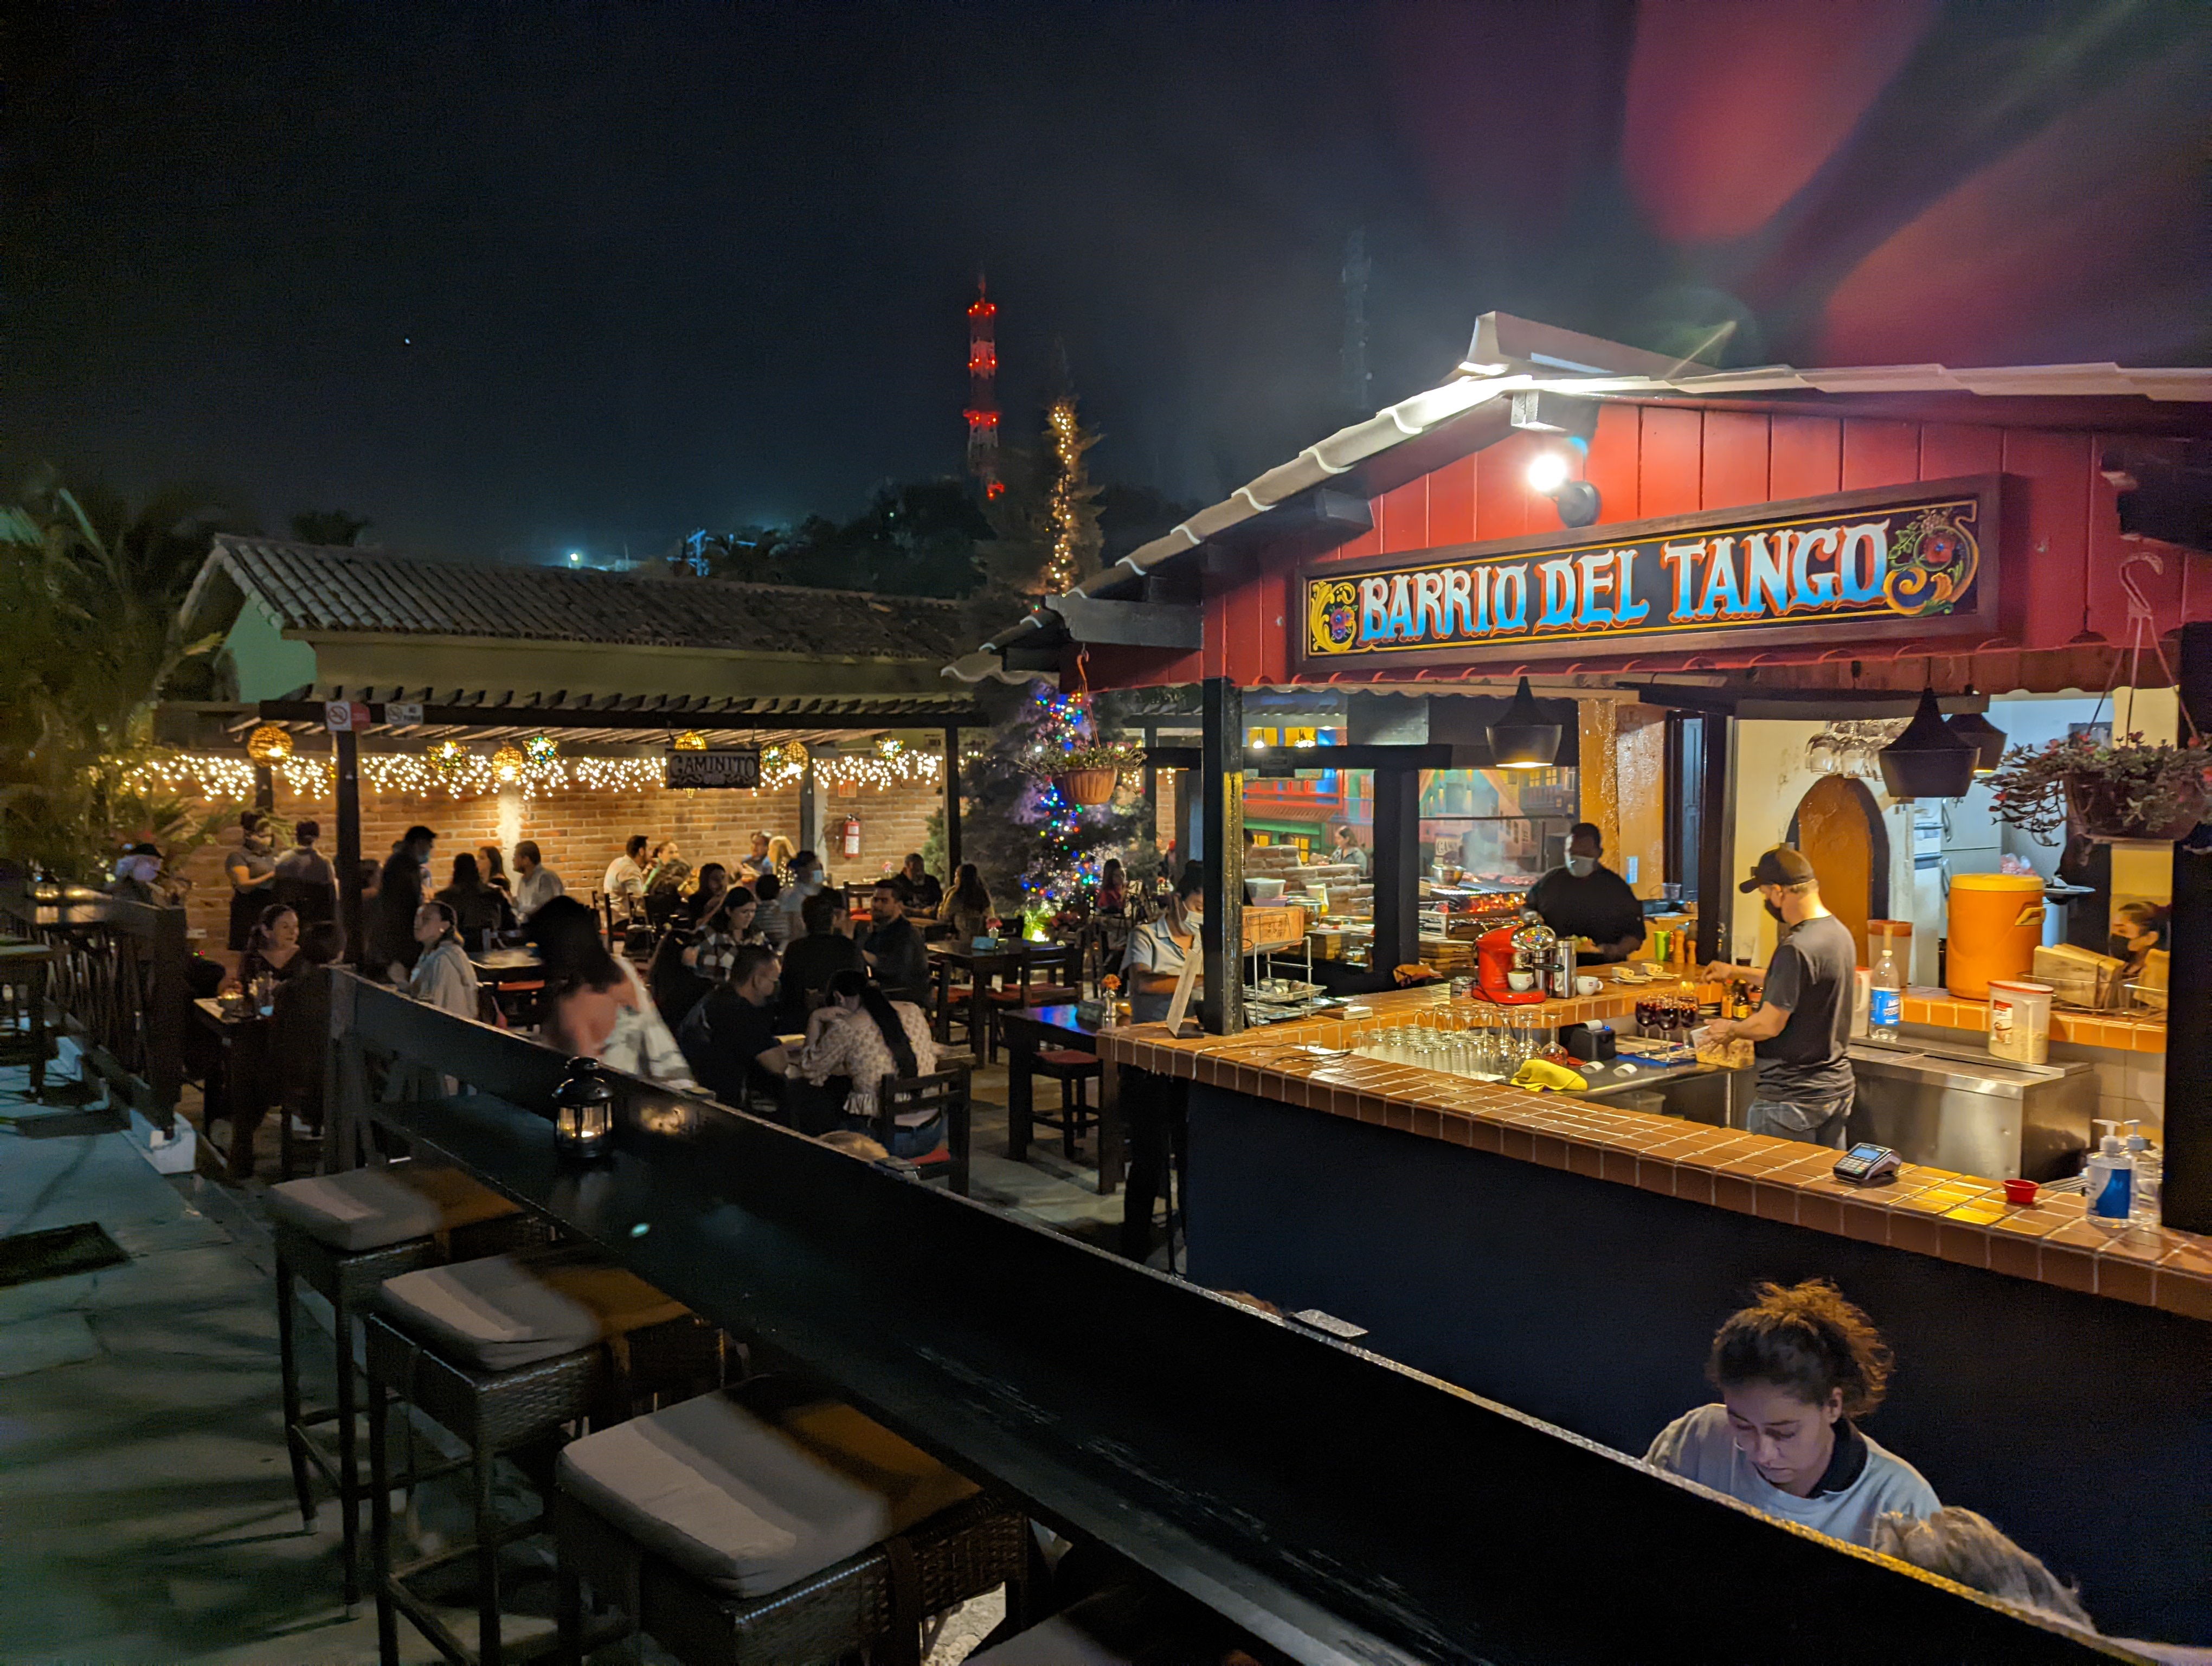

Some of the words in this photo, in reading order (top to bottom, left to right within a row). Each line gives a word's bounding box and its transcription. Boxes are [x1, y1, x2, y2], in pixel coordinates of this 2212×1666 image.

[1356, 561, 1528, 648] BARRIO
[1533, 548, 1650, 635] DEL
[1660, 518, 1891, 623] TANGO
[670, 754, 756, 778] CAMINITO
